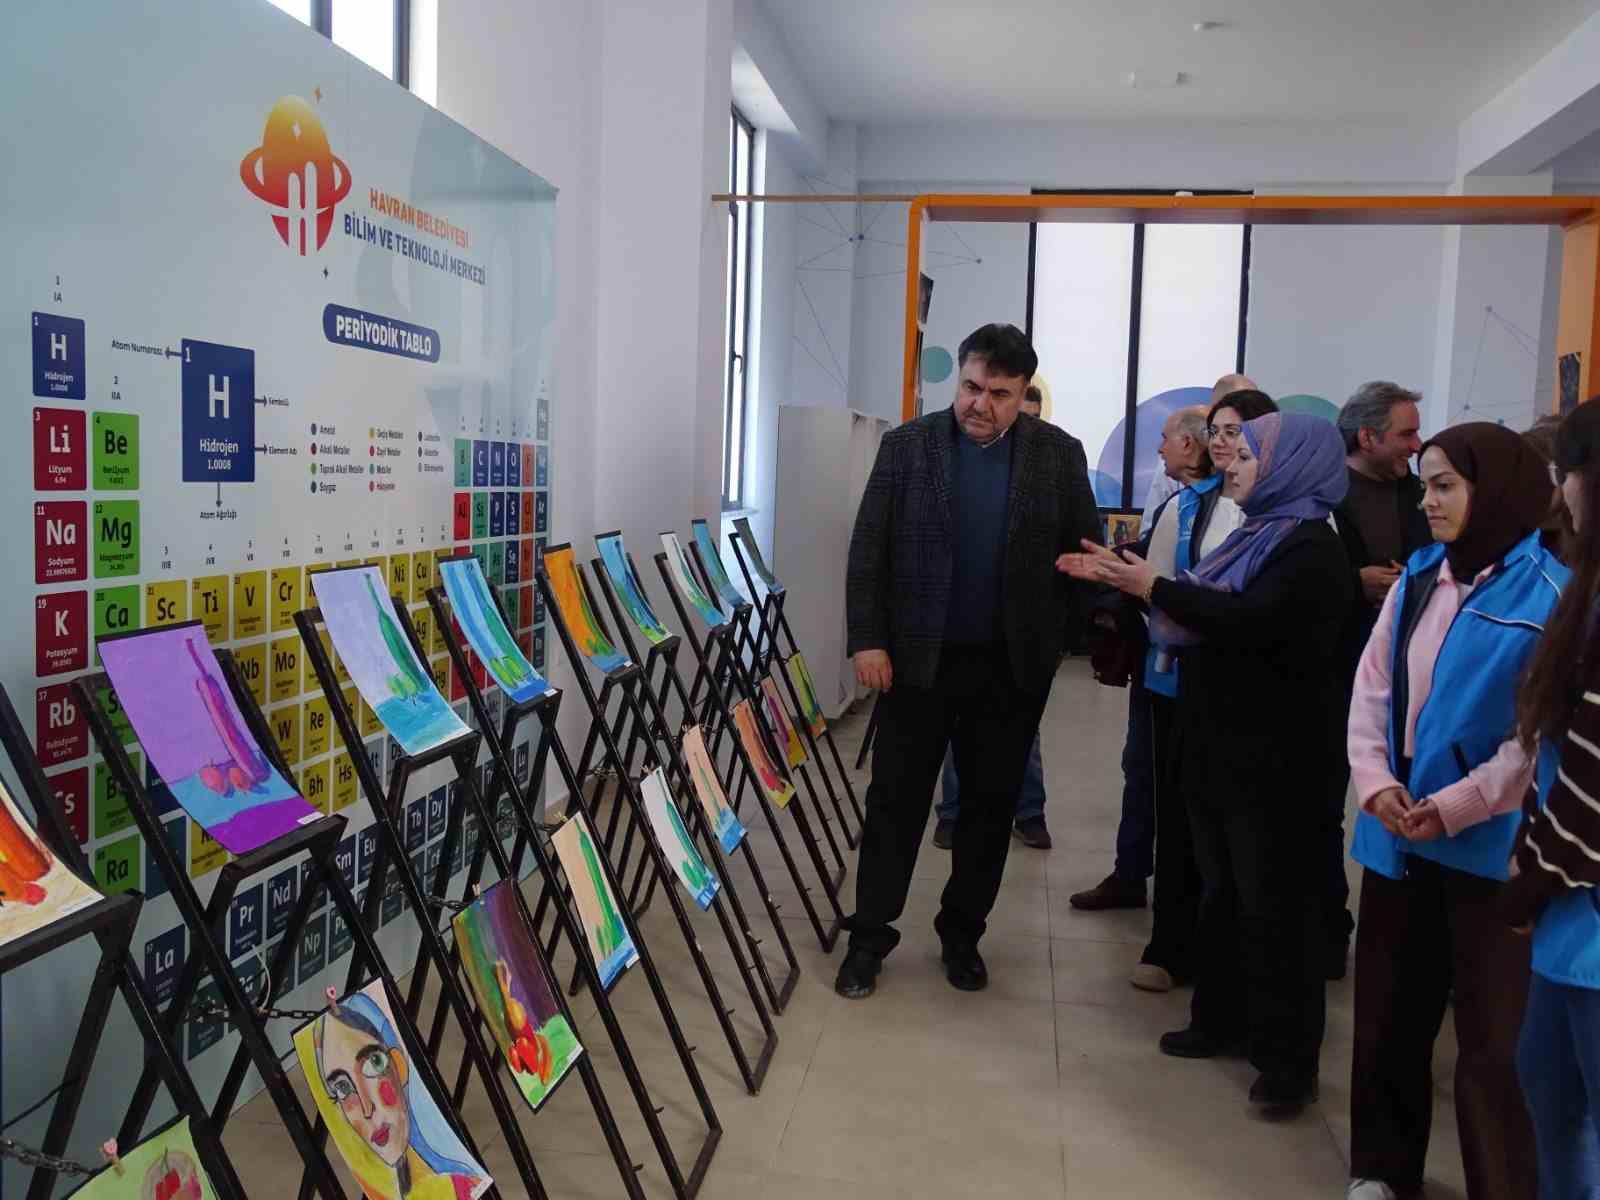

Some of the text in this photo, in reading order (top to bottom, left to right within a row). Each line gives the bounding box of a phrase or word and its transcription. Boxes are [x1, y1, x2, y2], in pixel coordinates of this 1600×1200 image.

[370, 187, 472, 248] HAVRAN BELEDİYESİ
[344, 211, 486, 286] BİLİM VE TEKNOLOJİ MERKEZİ
[336, 314, 432, 356] PERİYODİK TABLO
[51, 333, 67, 361] H
[185, 346, 191, 363] 1
[208, 373, 230, 419] H
[50, 424, 71, 453] Li
[104, 429, 128, 455] Be
[200, 438, 239, 457] Hidrojen
[478, 450, 484, 466] C
[511, 452, 516, 466] O
[511, 499, 516, 516] S
[45, 519, 77, 546] Na
[101, 517, 133, 549] Mg
[394, 564, 405, 583] Ni
[416, 562, 427, 580] Cu
[202, 589, 218, 614] Ti
[245, 584, 255, 607] V
[279, 581, 294, 602] Cr
[105, 602, 129, 629] Ca
[157, 597, 176, 621] Sc
[54, 609, 70, 637] K
[415, 620, 427, 640] Ag
[239, 656, 260, 681] Nb
[275, 652, 296, 673] Mo
[50, 697, 76, 729] Rb
[310, 711, 324, 731] Re
[278, 719, 292, 741] W
[518, 751, 526, 767] Lu
[309, 775, 324, 797] Bh
[338, 765, 353, 785] Hs
[411, 810, 423, 828] Tb
[432, 799, 443, 823] Dy
[363, 838, 376, 857] Eu
[106, 859, 129, 885] Ra
[335, 851, 352, 870] Sm
[272, 880, 291, 909] Nd
[239, 904, 255, 928] Pr
[303, 932, 320, 954] Np
[154, 948, 175, 975] La
